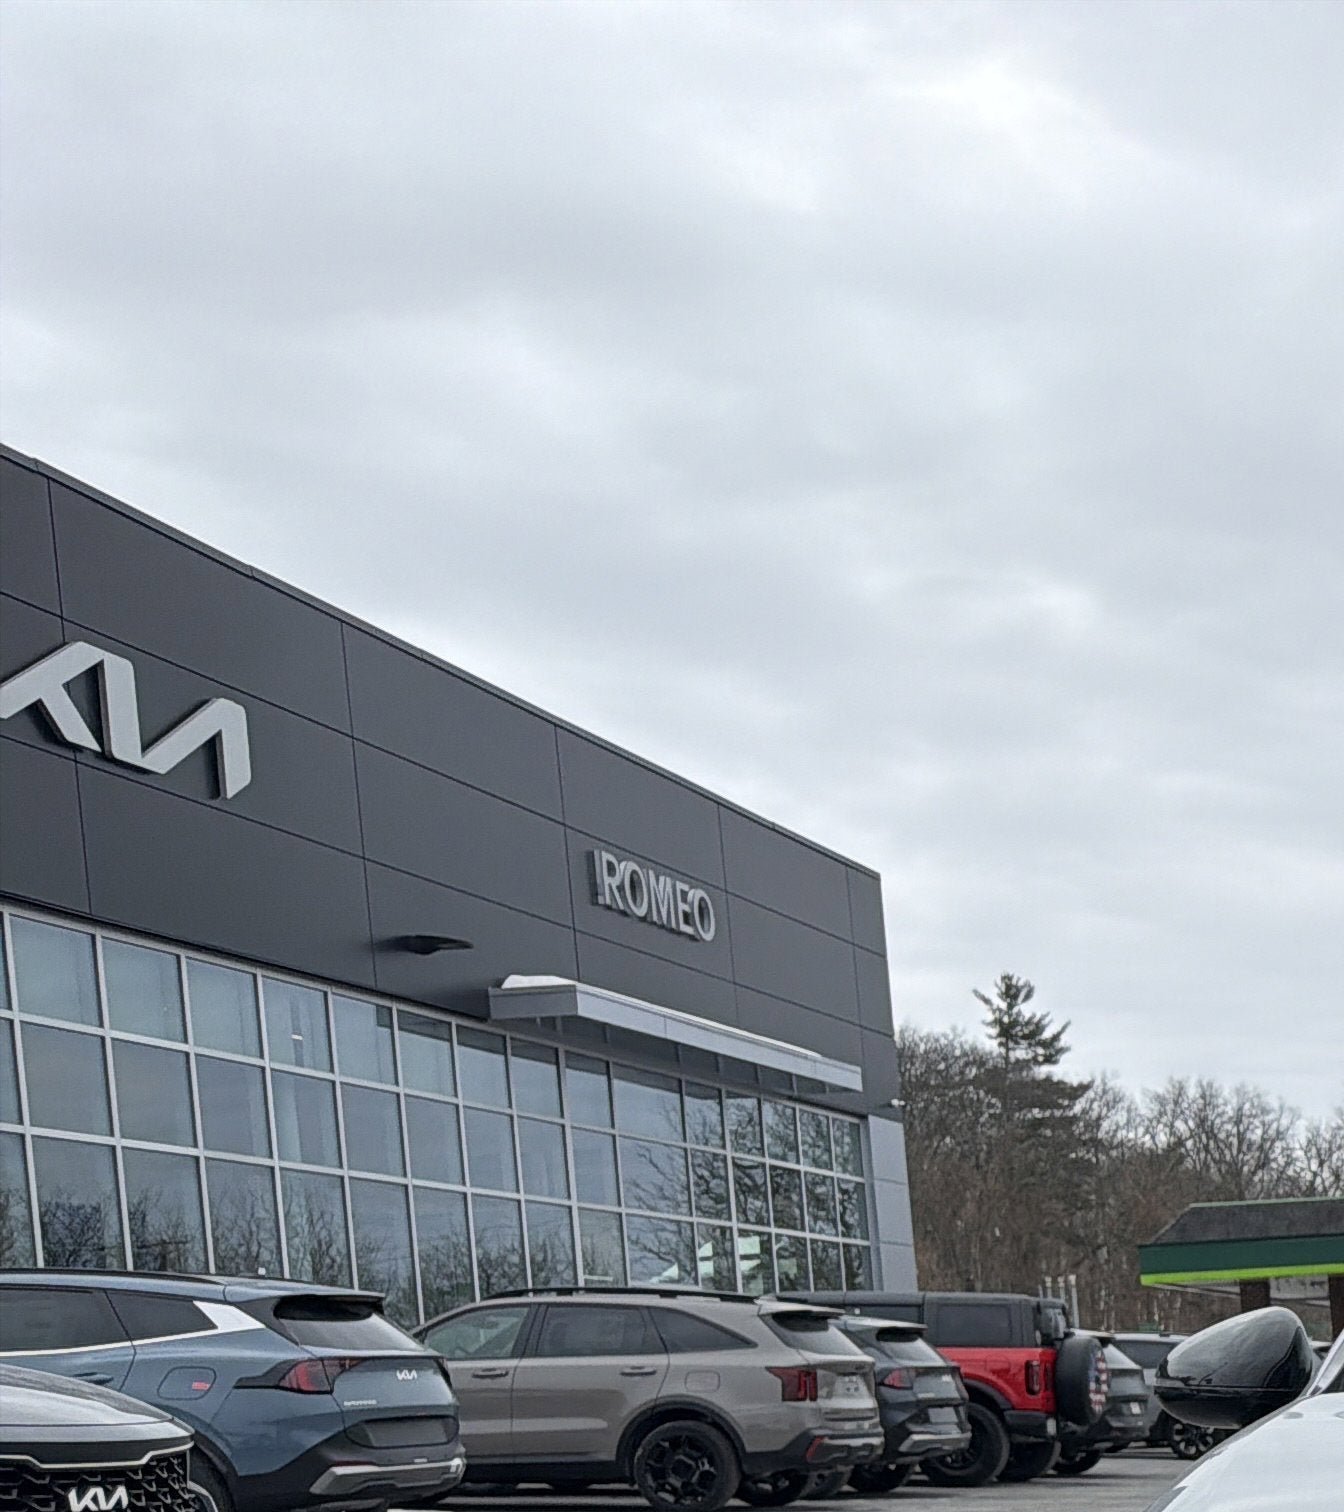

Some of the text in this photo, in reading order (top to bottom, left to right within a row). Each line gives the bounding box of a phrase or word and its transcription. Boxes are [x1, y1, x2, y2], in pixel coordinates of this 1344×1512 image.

[594, 849, 716, 942] ROMEO
[396, 1369, 417, 1380] KIA
[67, 1485, 129, 1512] KIA
